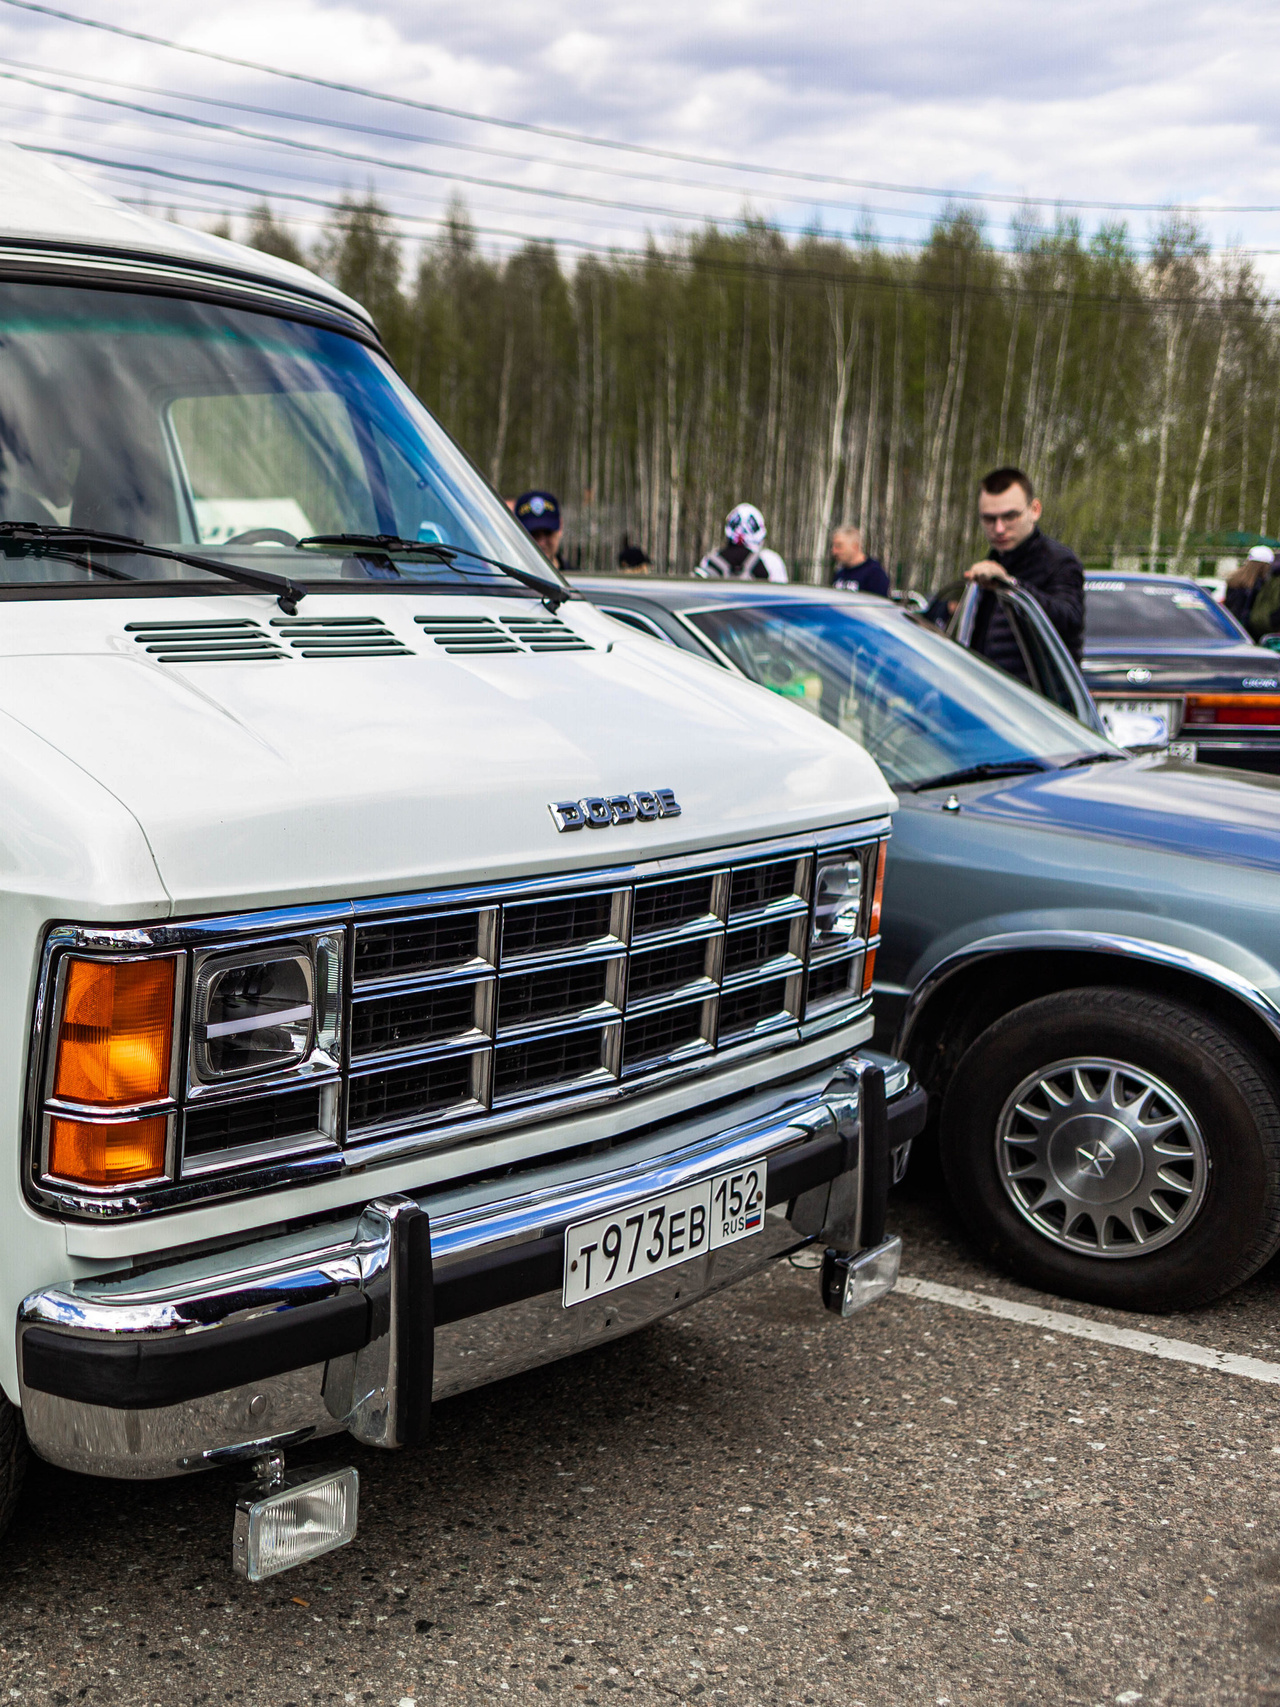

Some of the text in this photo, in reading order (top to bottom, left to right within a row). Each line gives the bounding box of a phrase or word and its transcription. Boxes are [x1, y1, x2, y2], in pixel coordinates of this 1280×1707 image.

[547, 788, 682, 833] DODGE
[714, 1169, 759, 1222] 152
[722, 1215, 745, 1238] RUS
